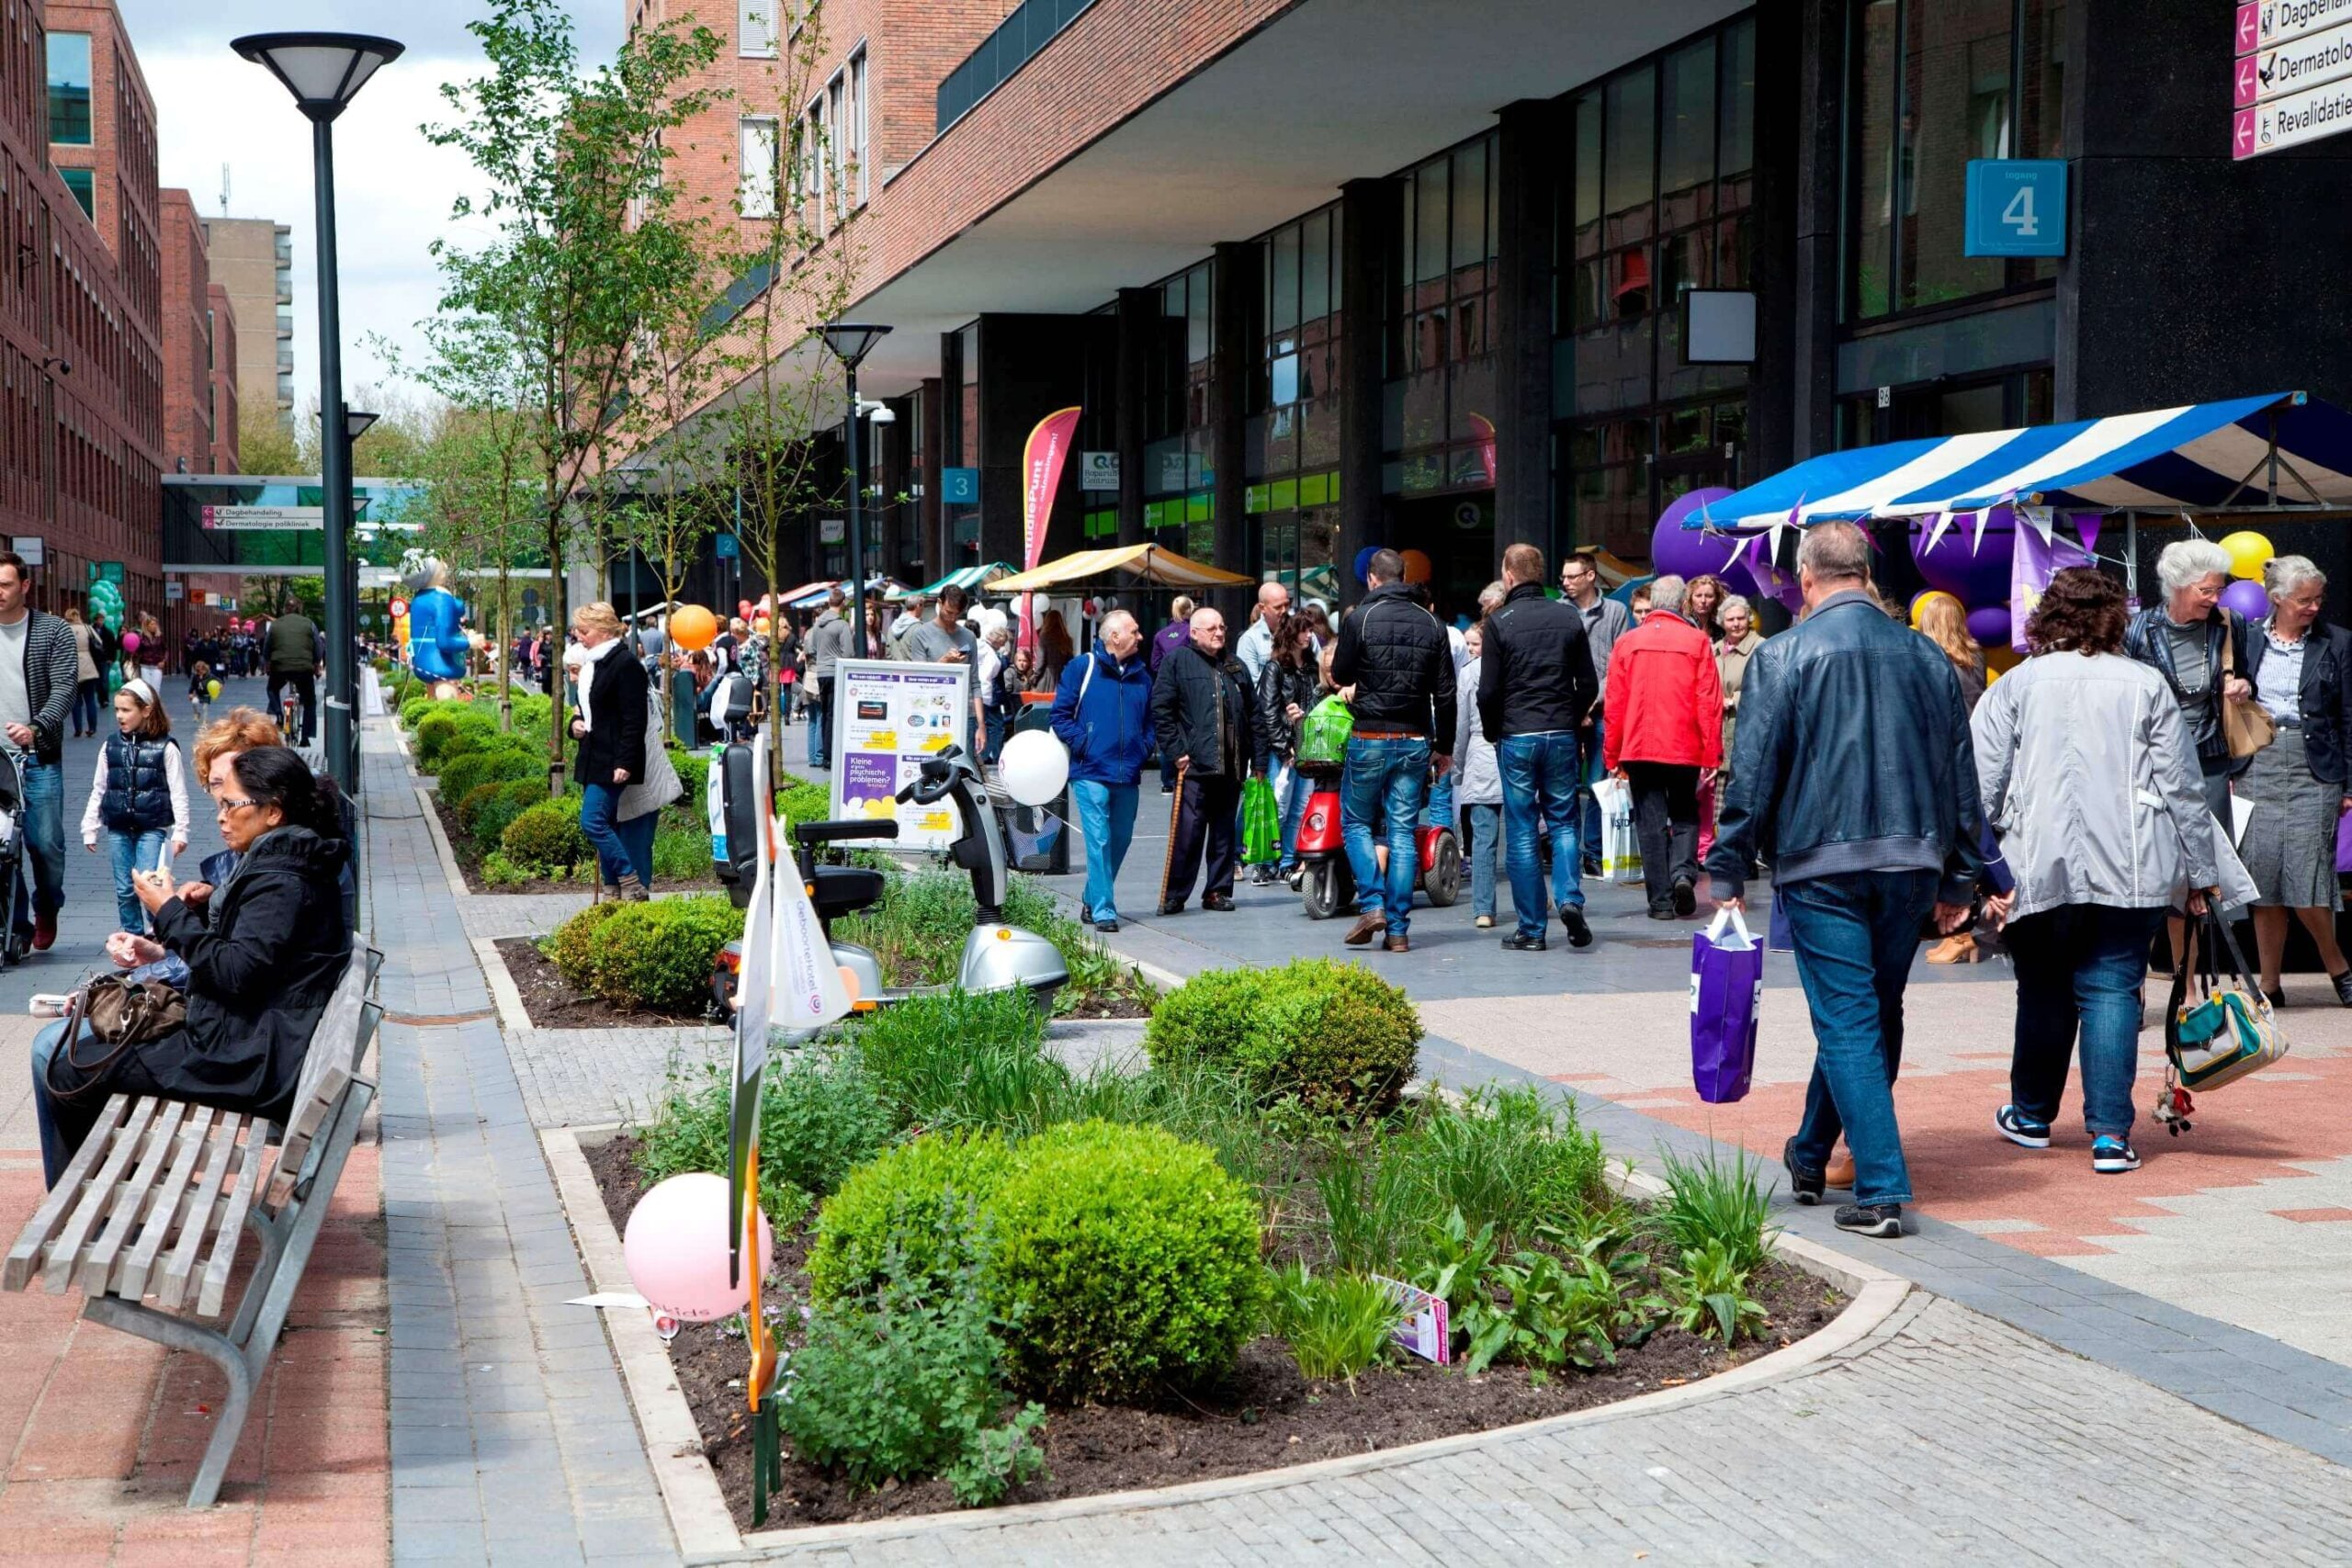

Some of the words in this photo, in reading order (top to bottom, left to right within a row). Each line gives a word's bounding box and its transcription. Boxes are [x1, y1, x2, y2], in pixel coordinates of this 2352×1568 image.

[2278, 93, 2352, 135] Revalidatie
[2002, 186, 2039, 236] 4
[955, 477, 968, 495] 3
[226, 509, 282, 517] Dagbehandeling
[226, 520, 273, 528] Dermatologie
[275, 520, 310, 528] polikliniek
[723, 540, 733, 551] 2
[850, 757, 873, 765] Kleine
[850, 776, 891, 784] problemen?
[797, 900, 819, 992] GeboorteHotel
